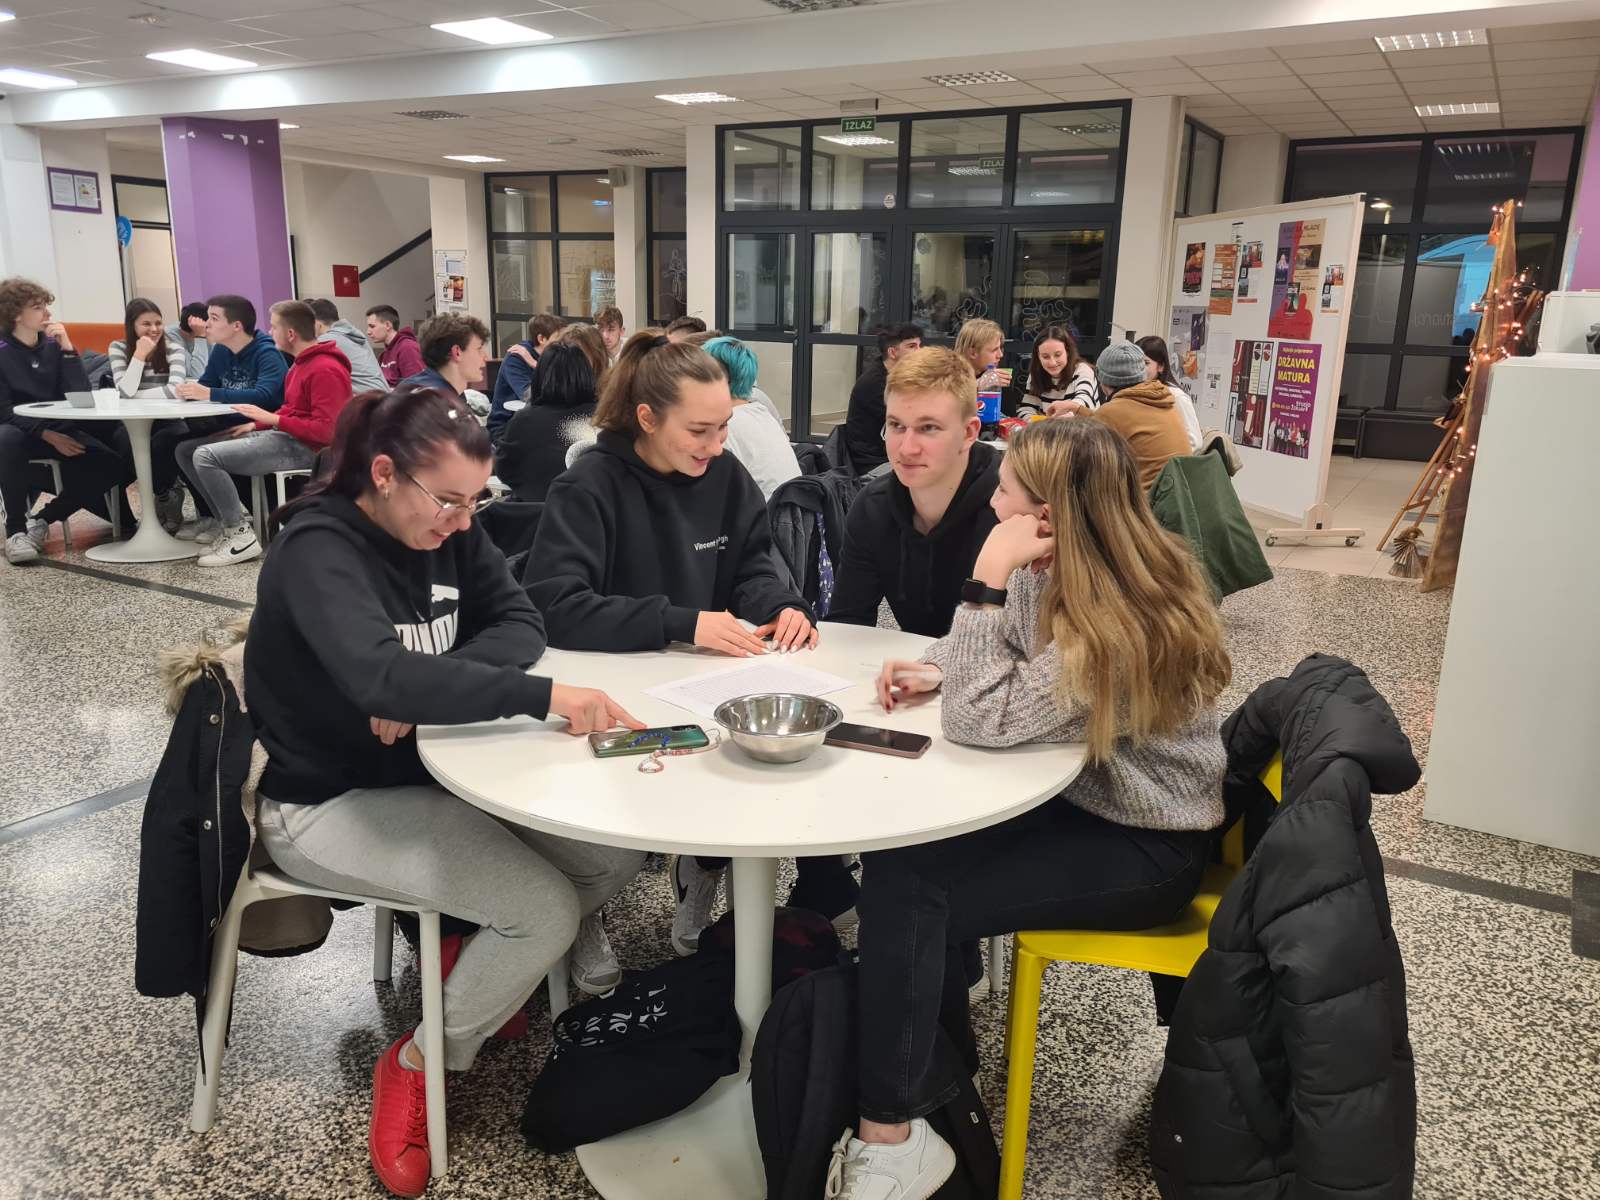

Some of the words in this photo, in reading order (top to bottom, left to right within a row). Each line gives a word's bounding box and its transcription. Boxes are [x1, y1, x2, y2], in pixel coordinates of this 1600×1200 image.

[845, 120, 872, 130] IZLAZ
[1278, 355, 1315, 369] DRŽAVNA
[1277, 370, 1311, 384] MATURA
